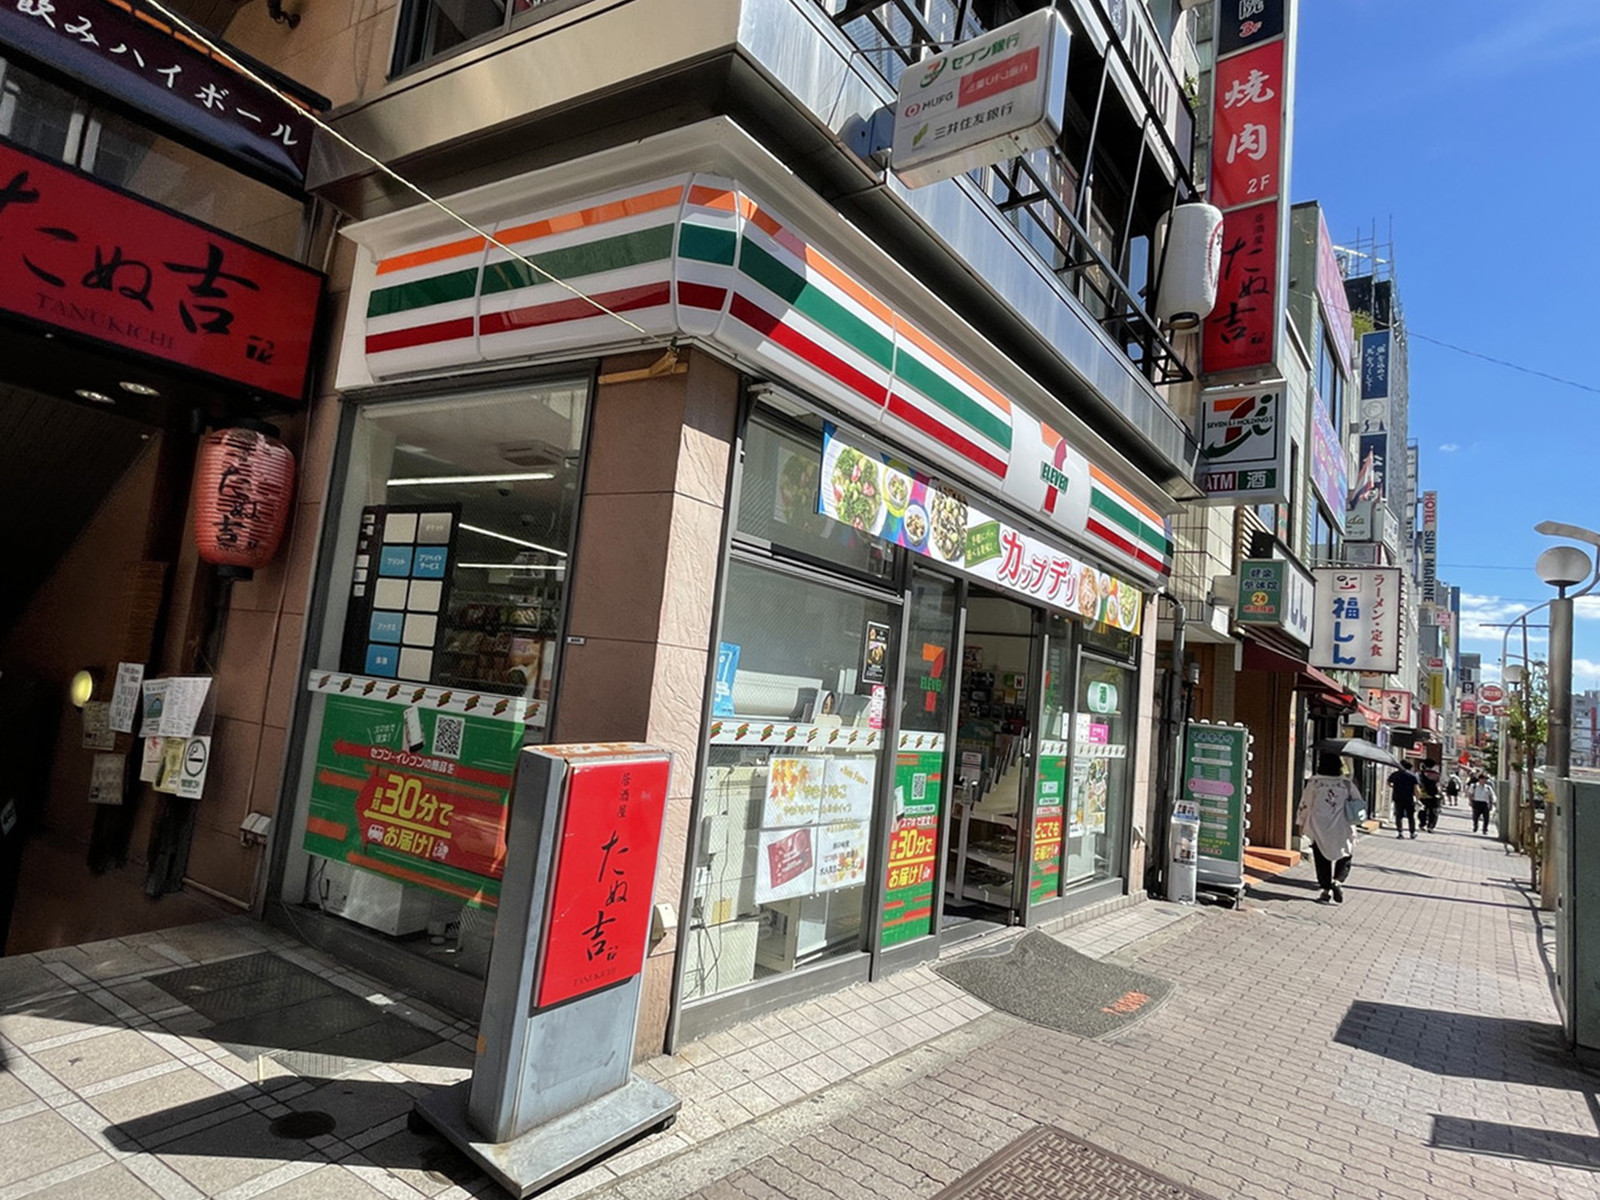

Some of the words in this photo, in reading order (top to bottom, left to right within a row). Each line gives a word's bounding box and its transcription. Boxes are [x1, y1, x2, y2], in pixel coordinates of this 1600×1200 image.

[952, 32, 1020, 71] セブン銀行
[922, 91, 954, 111] MUFG
[933, 101, 1014, 140] 三井住友銀行
[1223, 69, 1274, 164] 焼肉
[1247, 175, 1270, 195] 2F
[0, 169, 260, 334] たぬ吉
[1212, 236, 1270, 345] たぬ吉
[1206, 473, 1233, 490] ATM
[1246, 470, 1268, 489] 酒
[1424, 492, 1436, 523] HOTEL
[1424, 530, 1436, 554] SUN
[999, 531, 1076, 602] カップデリ
[1423, 558, 1436, 602] MARINE
[1253, 594, 1267, 603] 24
[1369, 574, 1385, 657] ラーメン・定食
[1332, 597, 1360, 665] 福しん
[616, 773, 632, 818] 居酒屋
[581, 830, 629, 962] たぬ吉
